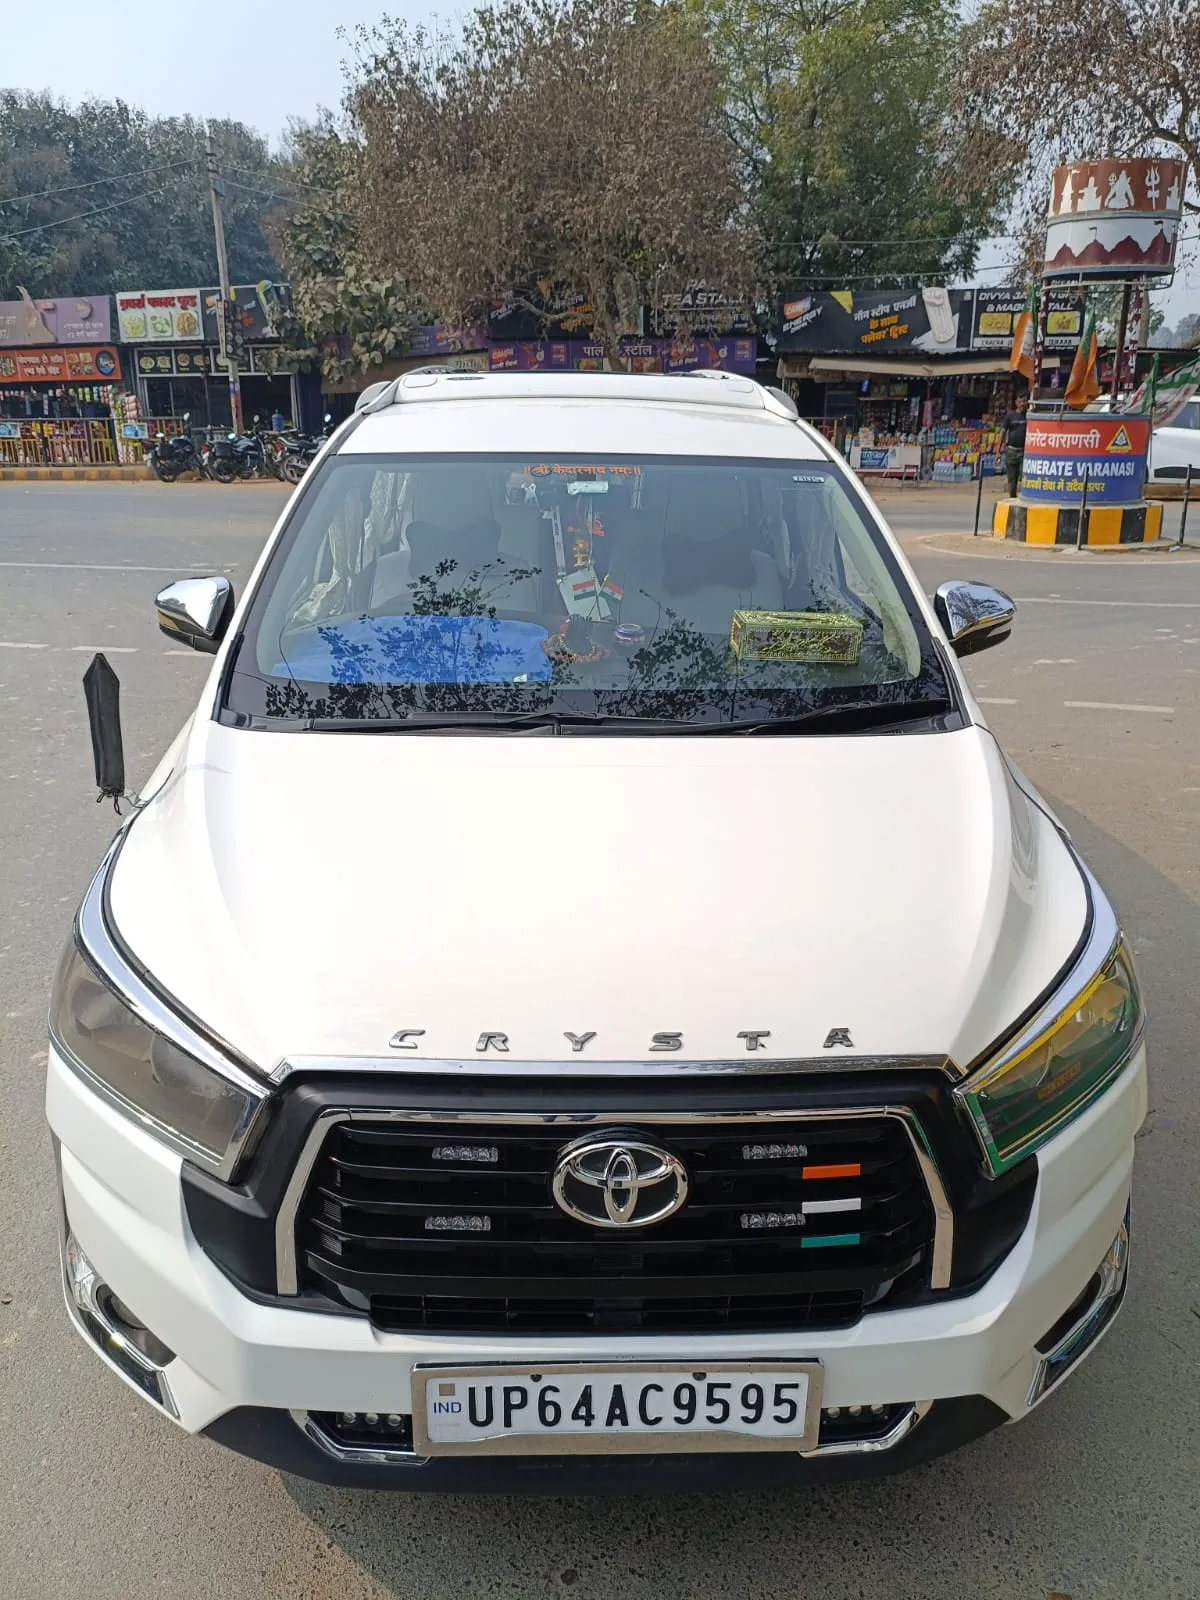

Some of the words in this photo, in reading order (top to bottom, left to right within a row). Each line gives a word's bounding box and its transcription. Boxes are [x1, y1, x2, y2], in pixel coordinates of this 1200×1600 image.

[662, 293, 693, 306] TEA
[978, 292, 1011, 301] DIVYA
[1046, 302, 1073, 310] TALL
[583, 346, 605, 357] पाल
[1048, 429, 1101, 449] वाराणसी
[1076, 461, 1135, 477] VARANASI
[388, 1027, 855, 1052] CRYSTA
[433, 1401, 462, 1414] IND
[468, 1382, 800, 1428] UP64AC9595
